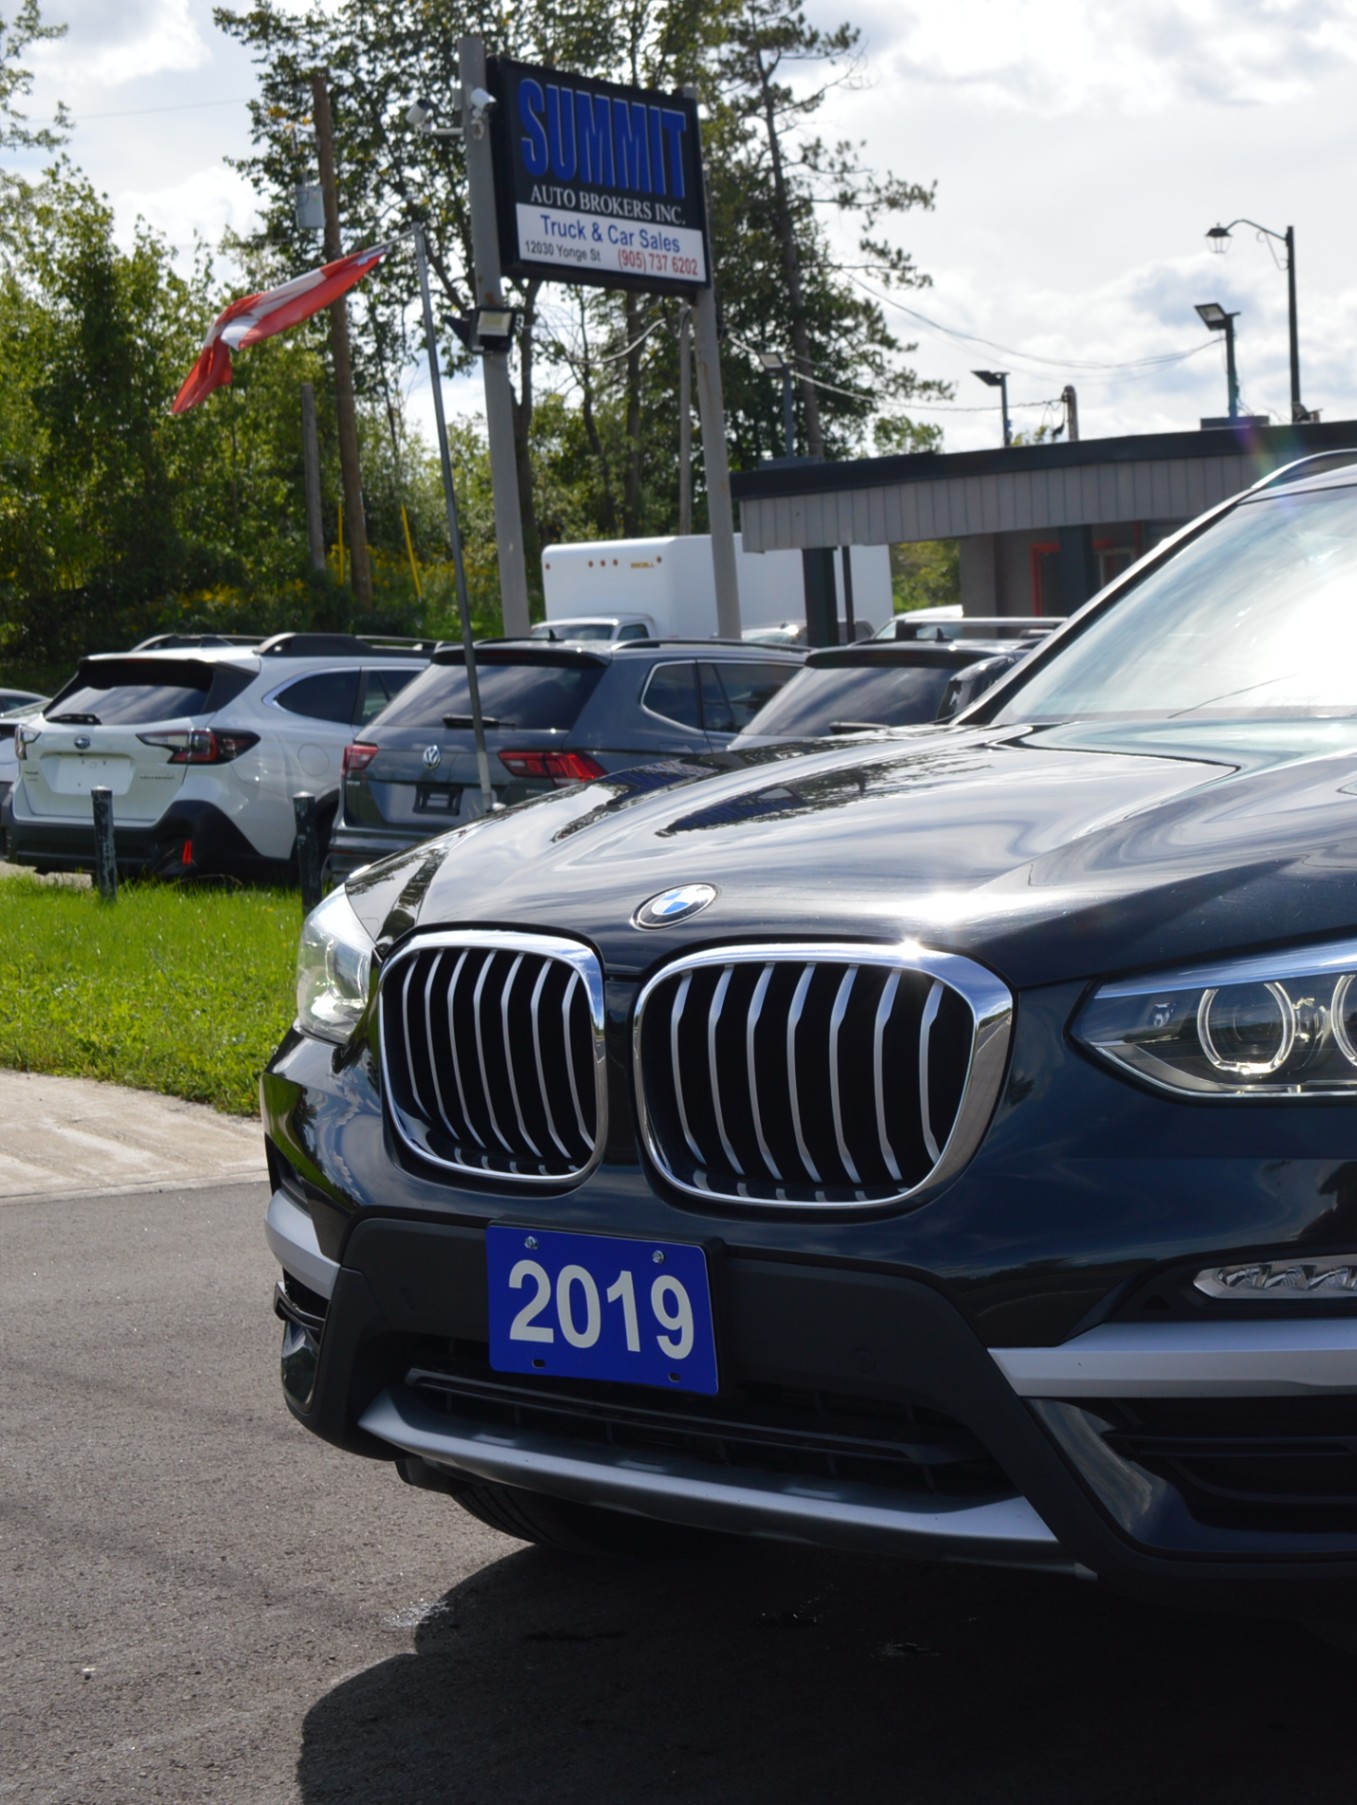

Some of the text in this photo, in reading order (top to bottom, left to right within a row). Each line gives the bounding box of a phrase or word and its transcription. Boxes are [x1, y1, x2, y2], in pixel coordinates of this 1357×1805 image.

[519, 78, 687, 198] SUMMIT
[531, 184, 686, 226] AUTO BROKERS INC.
[525, 240, 554, 257] 12030
[556, 244, 588, 262] Yonge
[540, 214, 681, 253] Truck & Car Sales
[618, 249, 698, 276] (905) 737 6202
[508, 1259, 694, 1360] 2019
